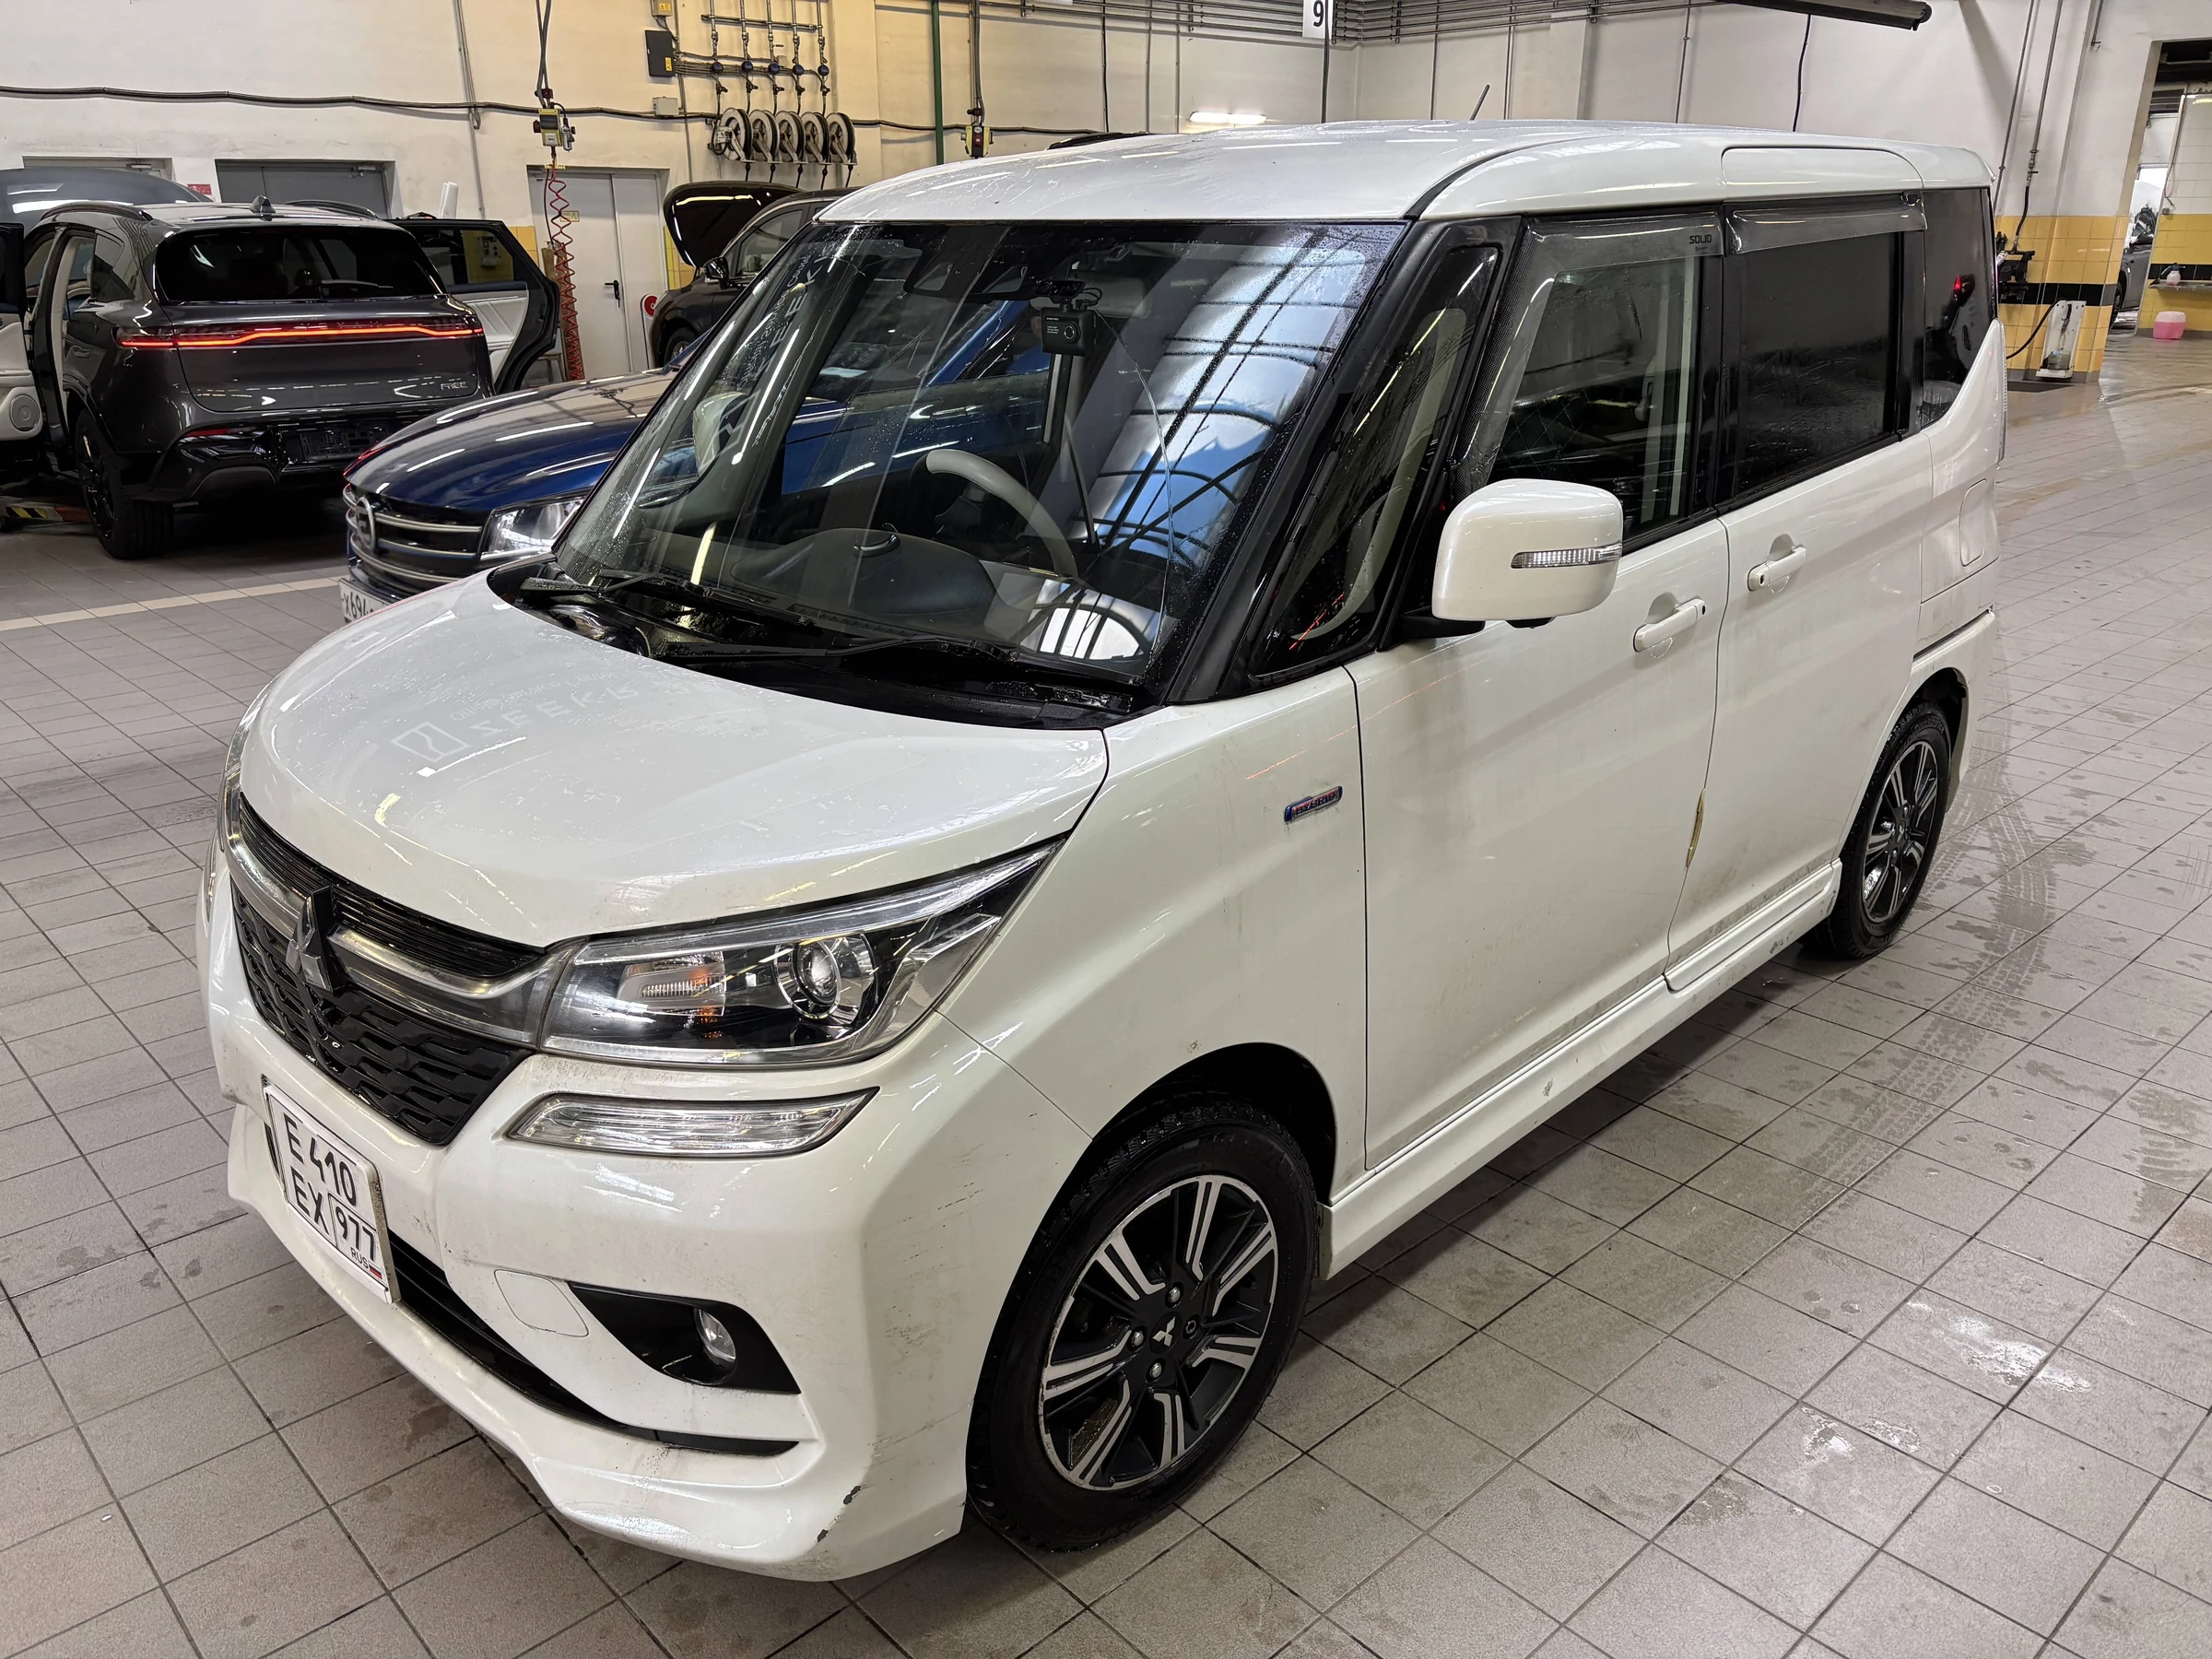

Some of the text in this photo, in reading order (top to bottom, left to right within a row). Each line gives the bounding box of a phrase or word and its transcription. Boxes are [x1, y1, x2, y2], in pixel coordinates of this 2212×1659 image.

[1313, 0, 1324, 27] 9
[1296, 792, 1336, 816] HYBRID
[335, 1206, 375, 1261] 977
[351, 1247, 369, 1268] RUS
